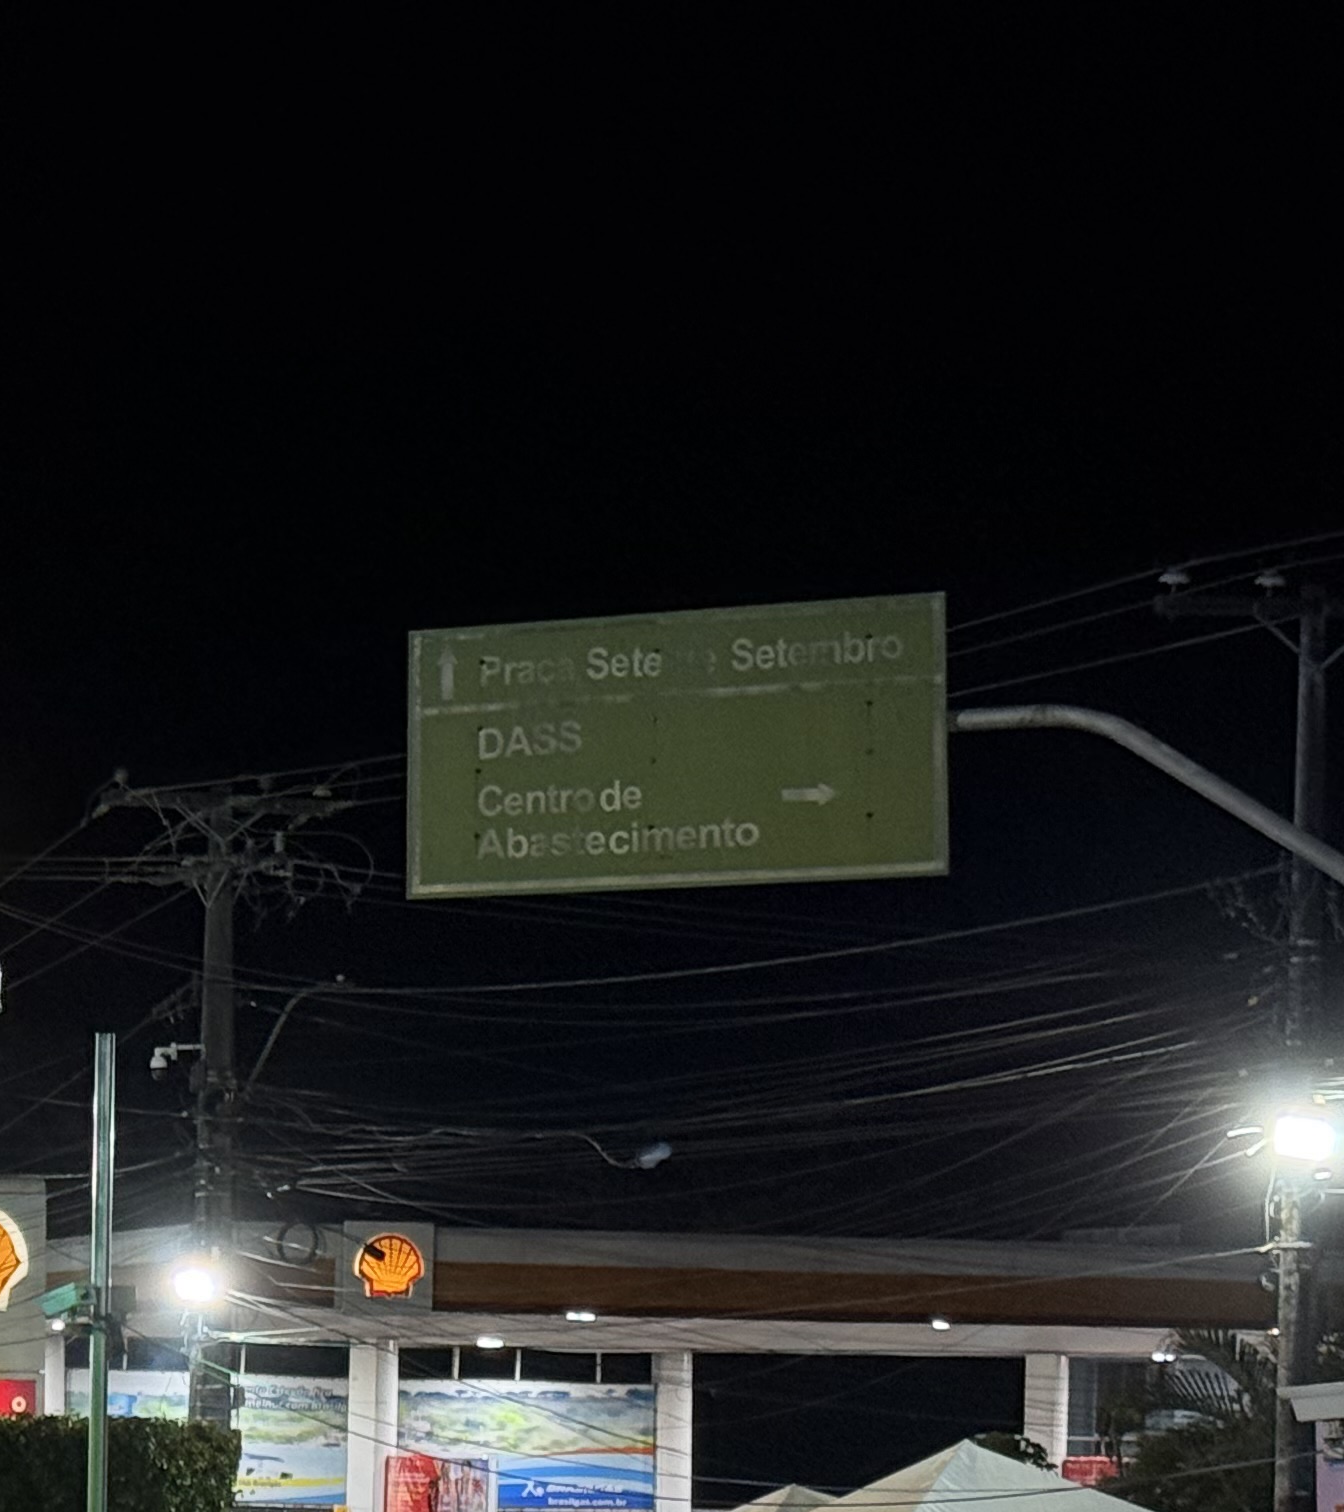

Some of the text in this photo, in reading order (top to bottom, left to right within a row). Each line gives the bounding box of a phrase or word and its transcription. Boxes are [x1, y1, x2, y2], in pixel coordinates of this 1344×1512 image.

[586, 647, 663, 680] Sete
[731, 632, 904, 672] Setembro
[478, 720, 583, 760] DASS
[477, 779, 643, 817] Centro de
[476, 816, 761, 861] Abastecimento
